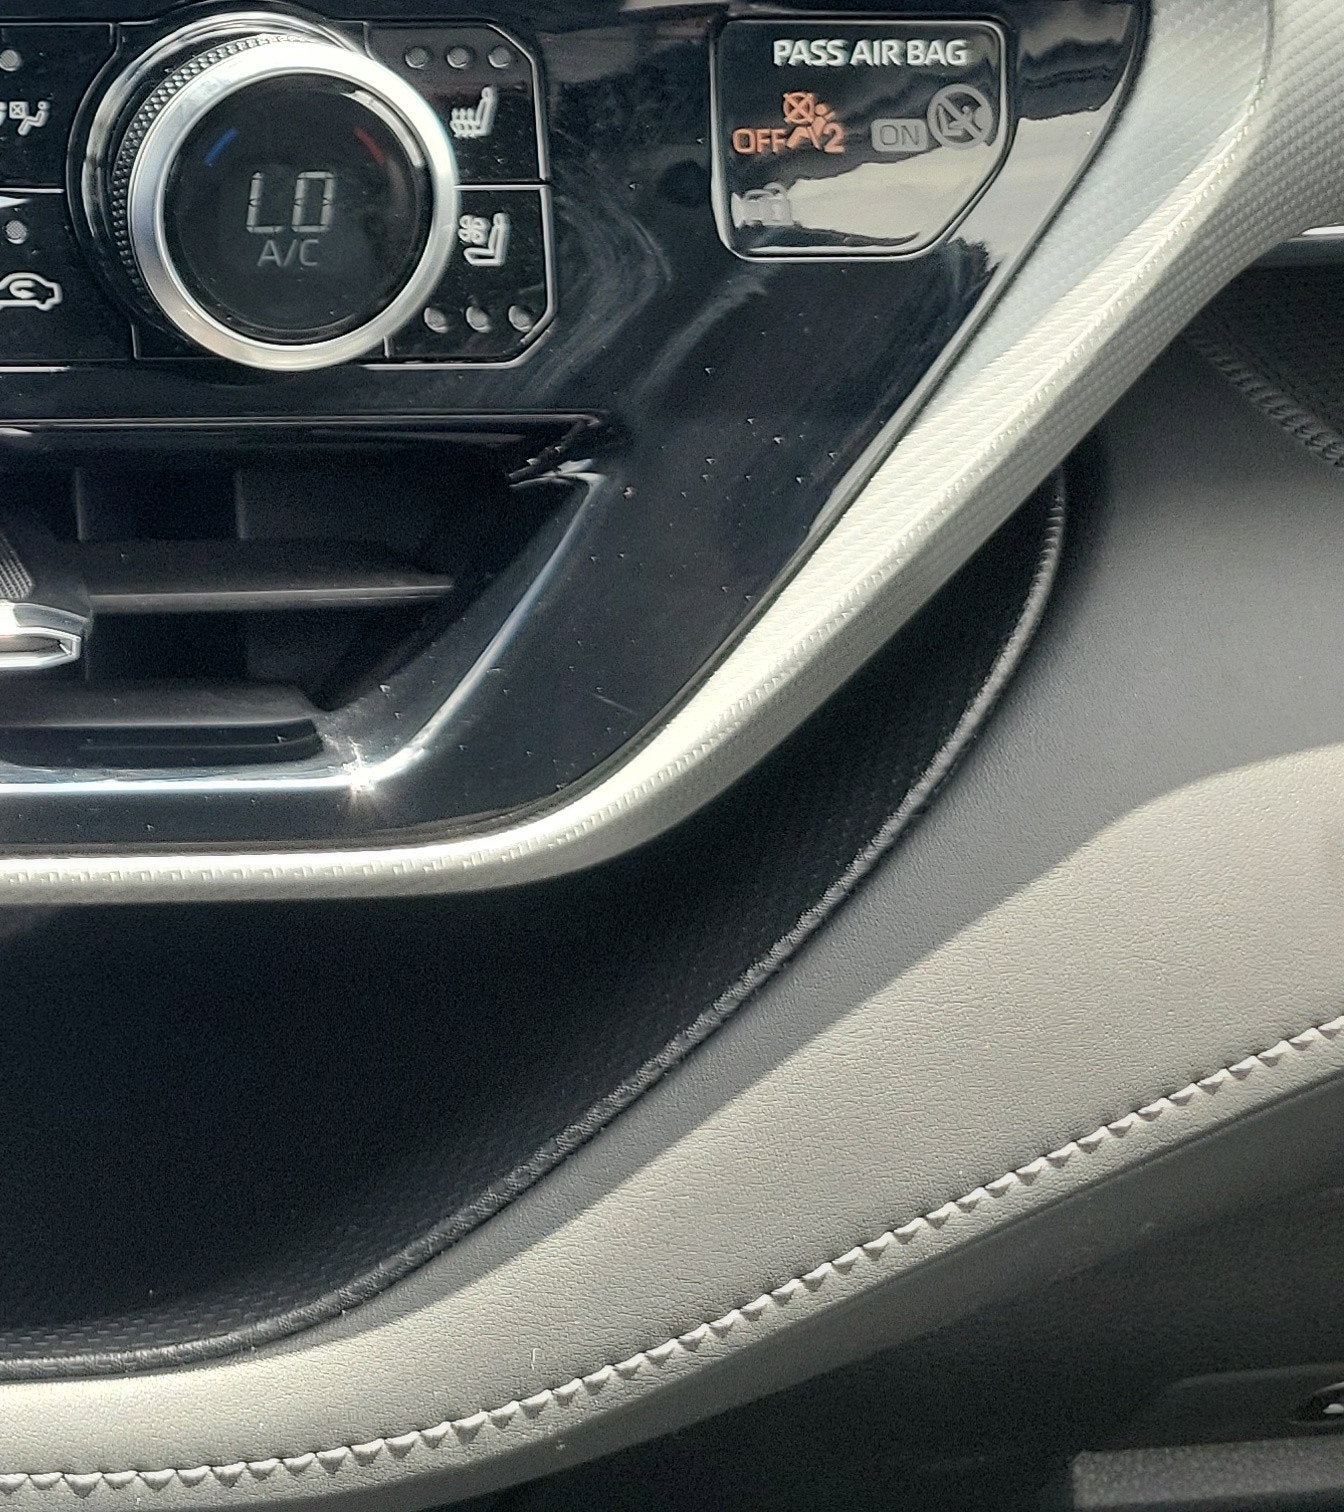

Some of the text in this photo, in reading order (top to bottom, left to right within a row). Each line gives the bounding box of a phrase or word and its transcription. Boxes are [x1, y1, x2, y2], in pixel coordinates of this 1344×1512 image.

[773, 39, 849, 66] PASS
[732, 128, 786, 155] OFF
[879, 124, 921, 147] ON
[257, 240, 319, 267] A/C
